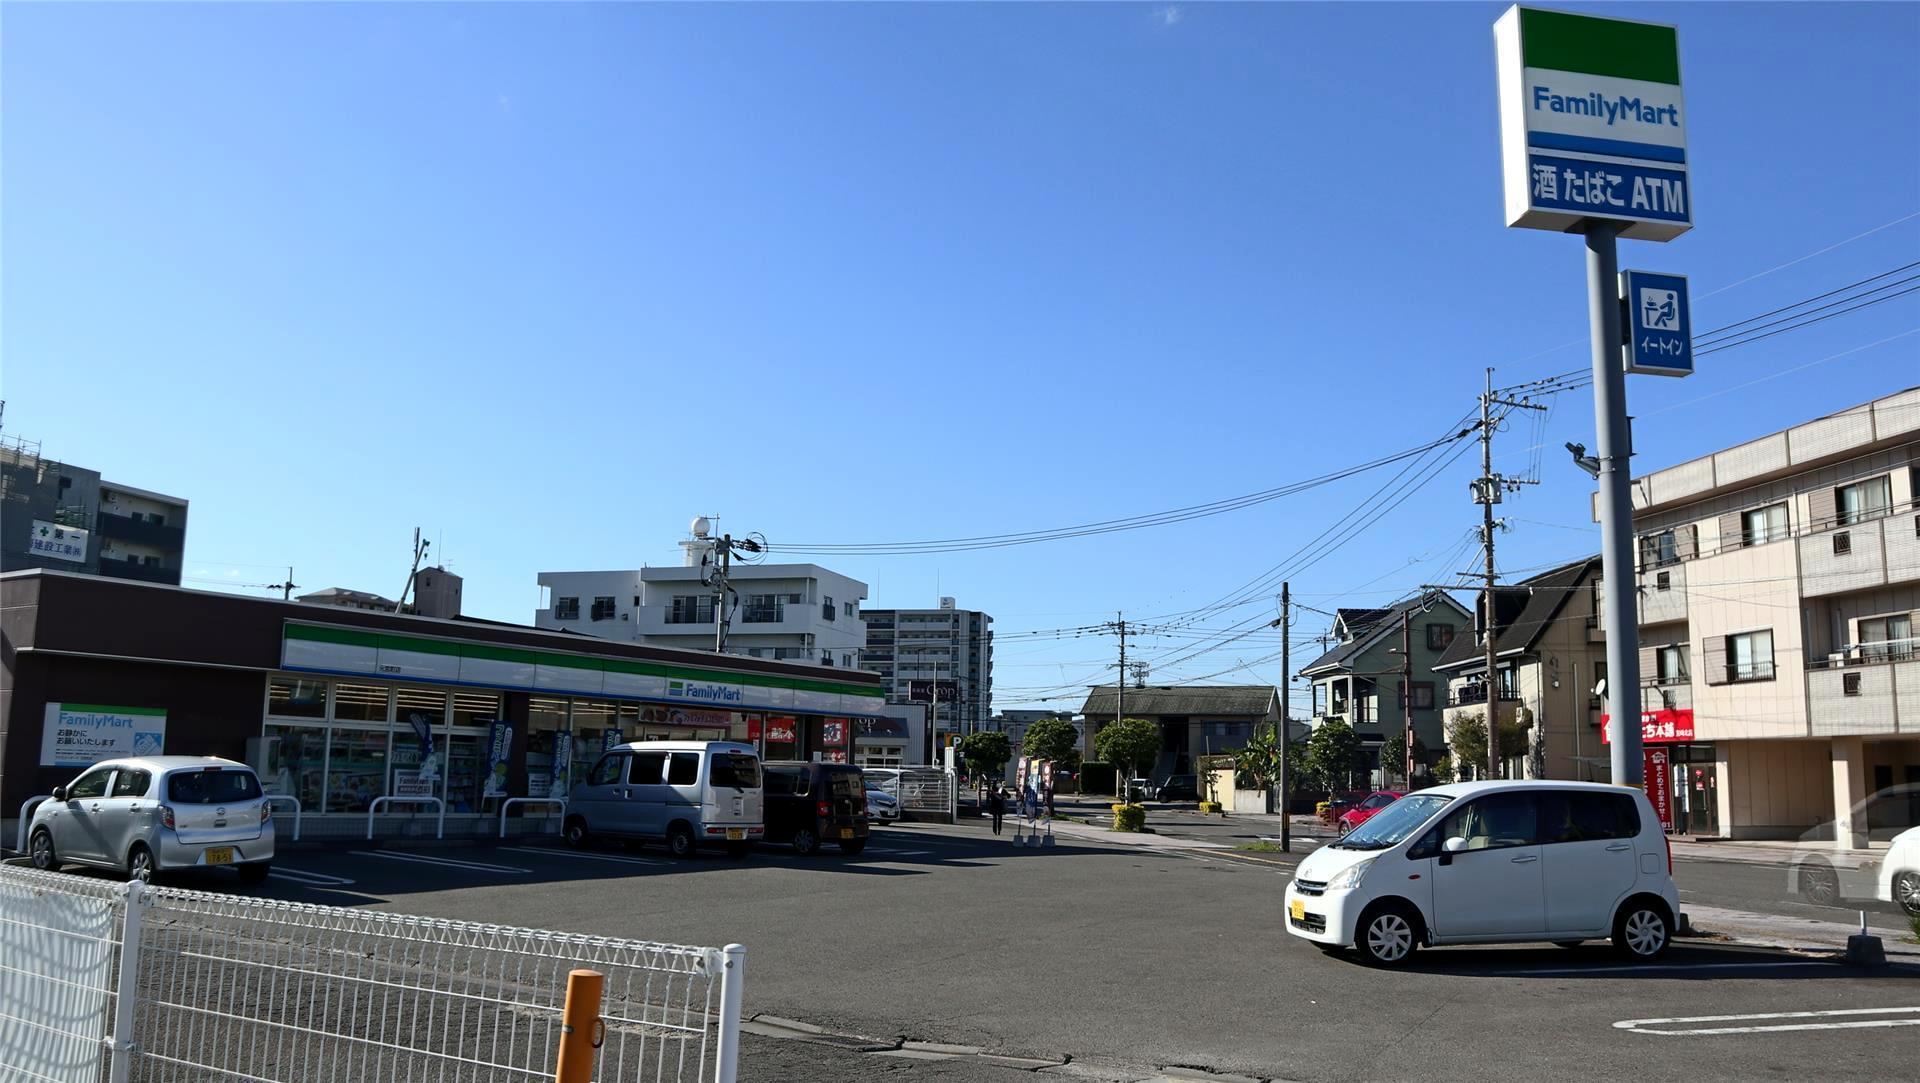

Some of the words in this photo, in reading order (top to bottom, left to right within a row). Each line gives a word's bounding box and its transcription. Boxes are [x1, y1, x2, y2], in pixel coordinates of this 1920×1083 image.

[1533, 86, 1678, 127] FamilyMart
[1533, 164, 1557, 200] 酒
[1564, 168, 1625, 207] たばこ
[1631, 175, 1684, 215] ATM
[1641, 337, 1683, 357] イートイン
[686, 683, 741, 701] FamilyMart
[58, 712, 133, 729] FamilyMart
[57, 729, 88, 737] お静かに
[56, 737, 116, 747] お願いいたします
[953, 736, 962, 748] P
